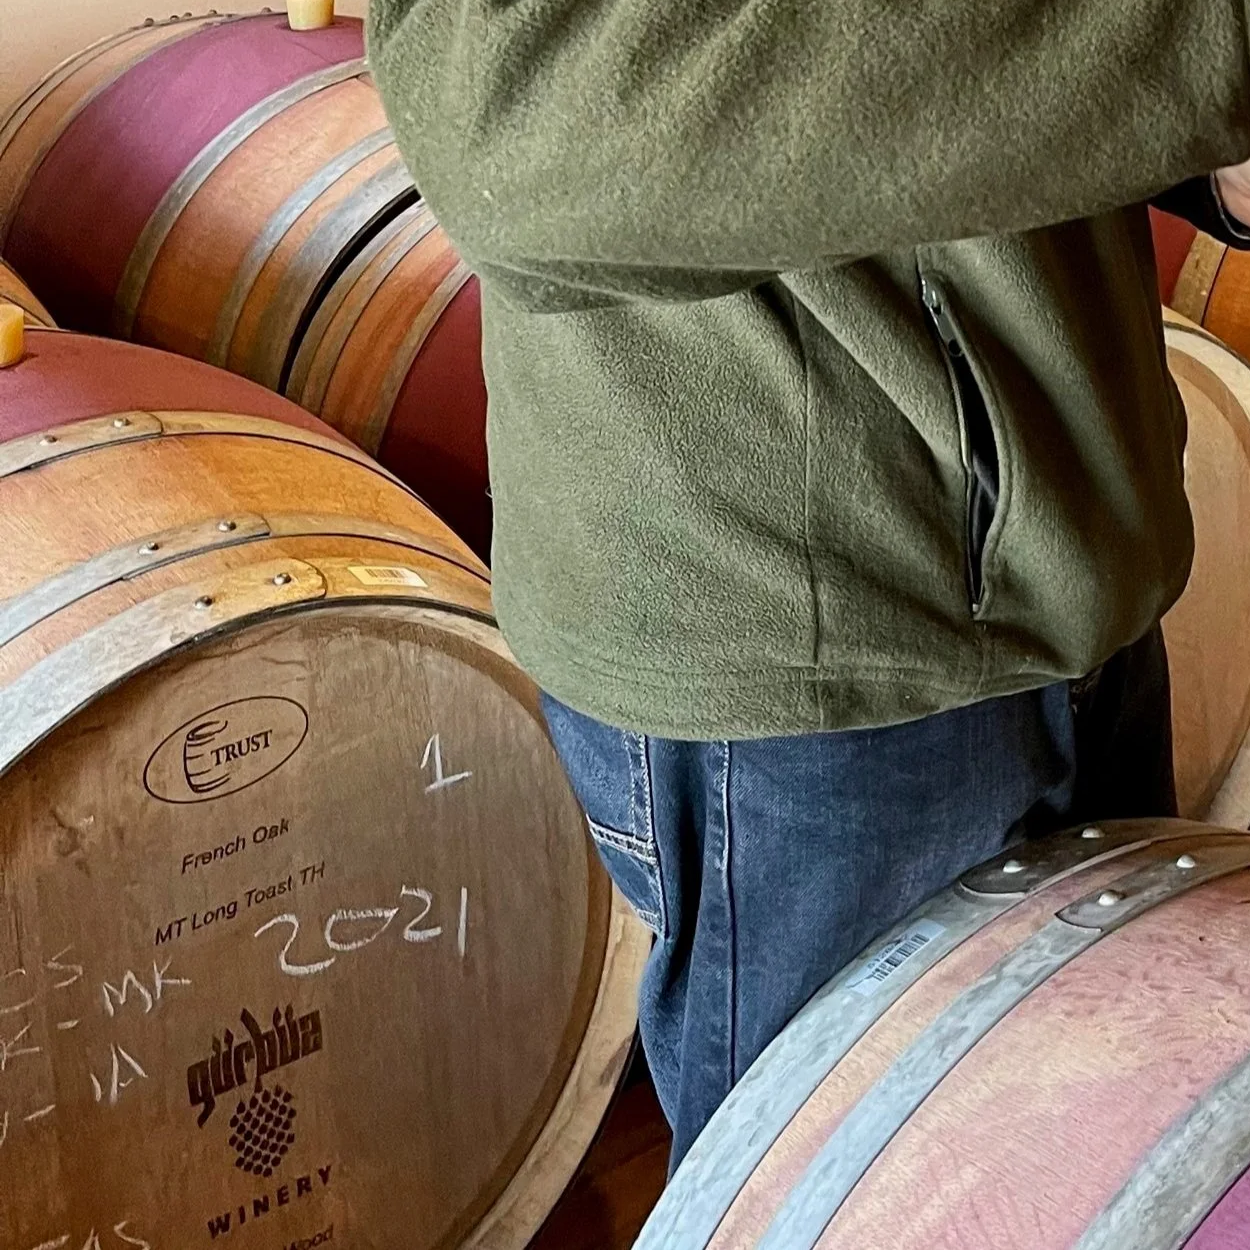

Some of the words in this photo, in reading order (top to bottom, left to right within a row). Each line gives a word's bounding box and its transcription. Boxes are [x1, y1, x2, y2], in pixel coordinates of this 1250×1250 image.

[210, 730, 273, 767] TRUST
[421, 733, 473, 794] 1
[181, 835, 246, 874] French
[252, 818, 290, 845] Oak
[155, 918, 188, 946] MT
[191, 901, 238, 931] Long
[244, 875, 293, 908] Toast
[299, 861, 326, 886] TH
[254, 886, 469, 976] 2021
[206, 1165, 333, 1240] WINERY
